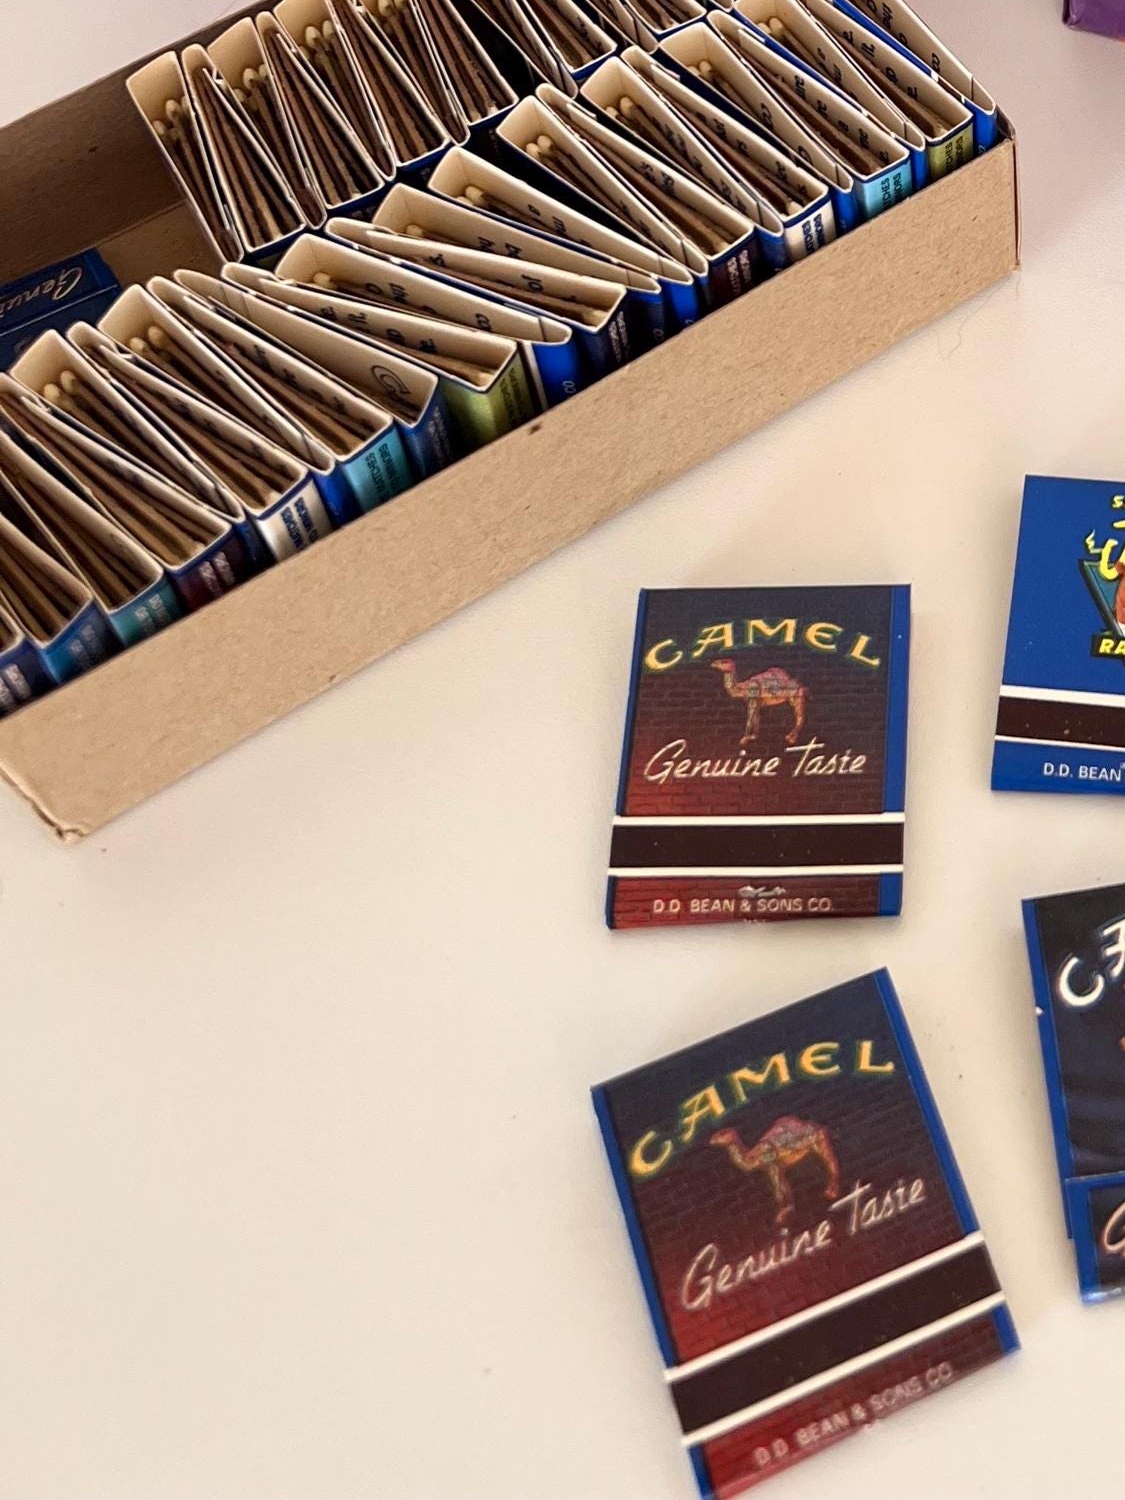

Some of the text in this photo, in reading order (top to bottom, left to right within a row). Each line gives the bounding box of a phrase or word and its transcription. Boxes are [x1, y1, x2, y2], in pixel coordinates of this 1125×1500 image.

[644, 618, 880, 671] CAMEL
[644, 736, 866, 785] Genuine Taste
[1079, 765, 1121, 781] BEAN
[690, 899, 735, 913] BEAN
[740, 899, 751, 912] &
[757, 898, 802, 912] SONS
[629, 1040, 895, 1178] CAMEL
[681, 1177, 926, 1311] Genuine Taste
[796, 1411, 849, 1445] BEAN
[851, 1402, 867, 1421] &
[870, 1376, 922, 1412] SONS
